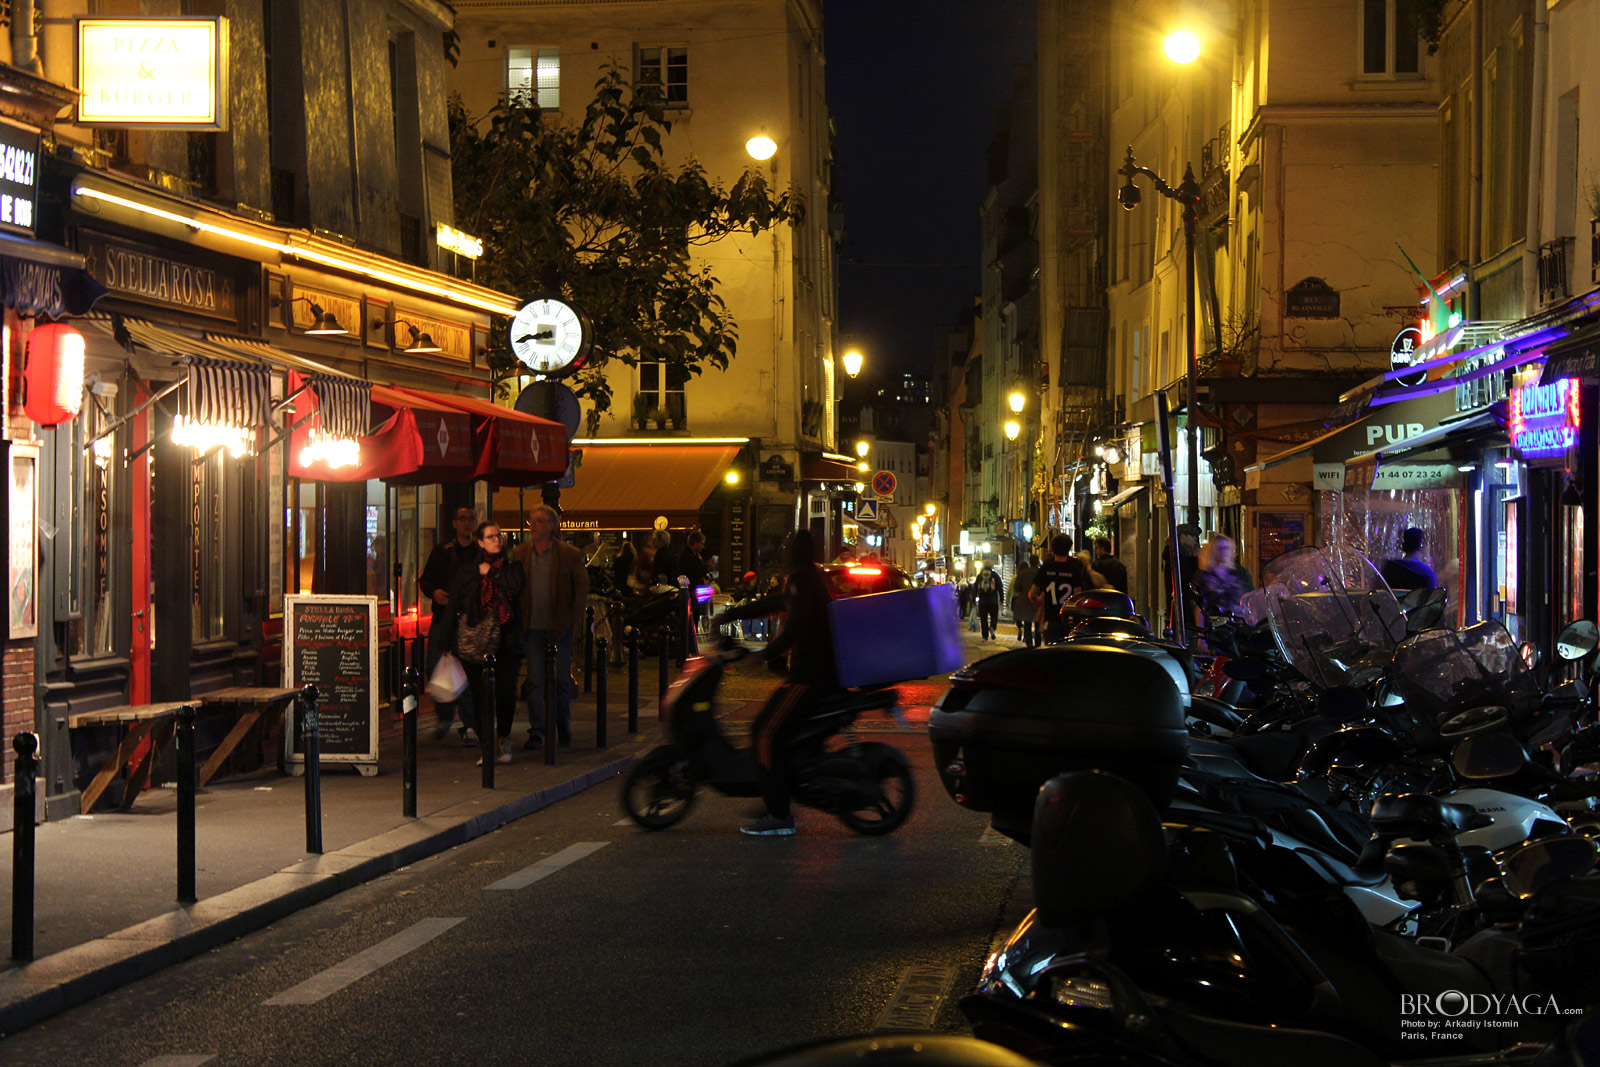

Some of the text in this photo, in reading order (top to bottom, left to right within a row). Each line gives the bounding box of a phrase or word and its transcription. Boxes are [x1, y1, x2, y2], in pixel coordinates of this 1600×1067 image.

[114, 37, 180, 53] PIZZA
[138, 62, 156, 79] &
[100, 88, 194, 105] BURGER
[1291, 304, 1334, 312] BLAINVILLE
[1319, 471, 1340, 479] WIFI
[1402, 471, 1413, 479] 07
[1430, 470, 1441, 478] 24
[1046, 581, 1073, 606] 12
[305, 605, 355, 614] STELLA ROSA
